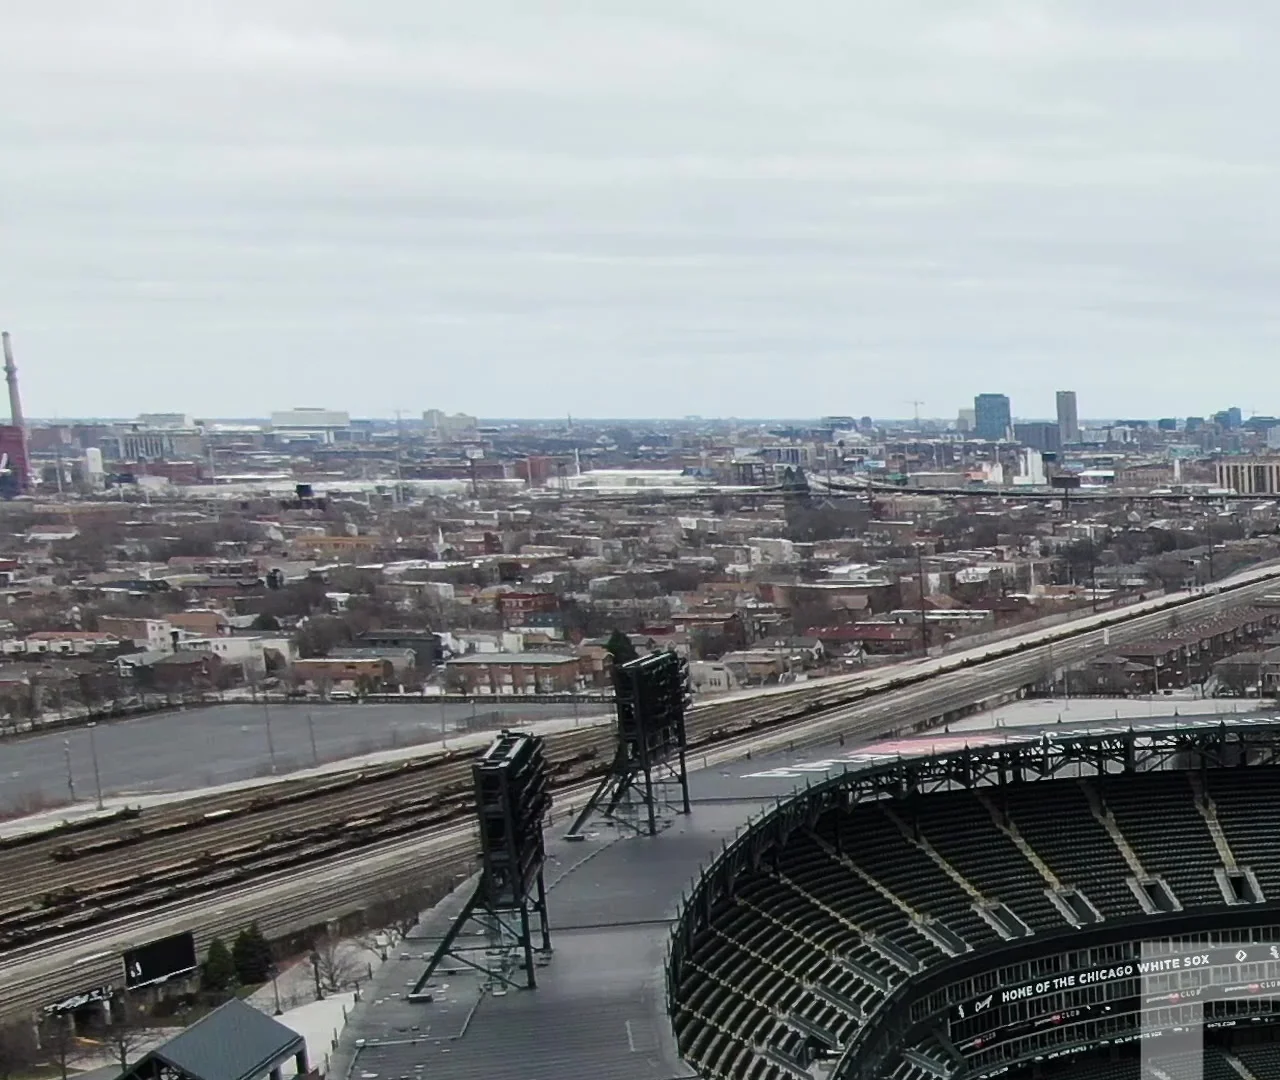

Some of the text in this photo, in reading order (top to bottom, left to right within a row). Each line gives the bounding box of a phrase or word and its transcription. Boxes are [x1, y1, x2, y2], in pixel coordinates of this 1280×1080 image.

[1002, 954, 1210, 1002] HOME OF THE CHICAGO WHITE SOX
